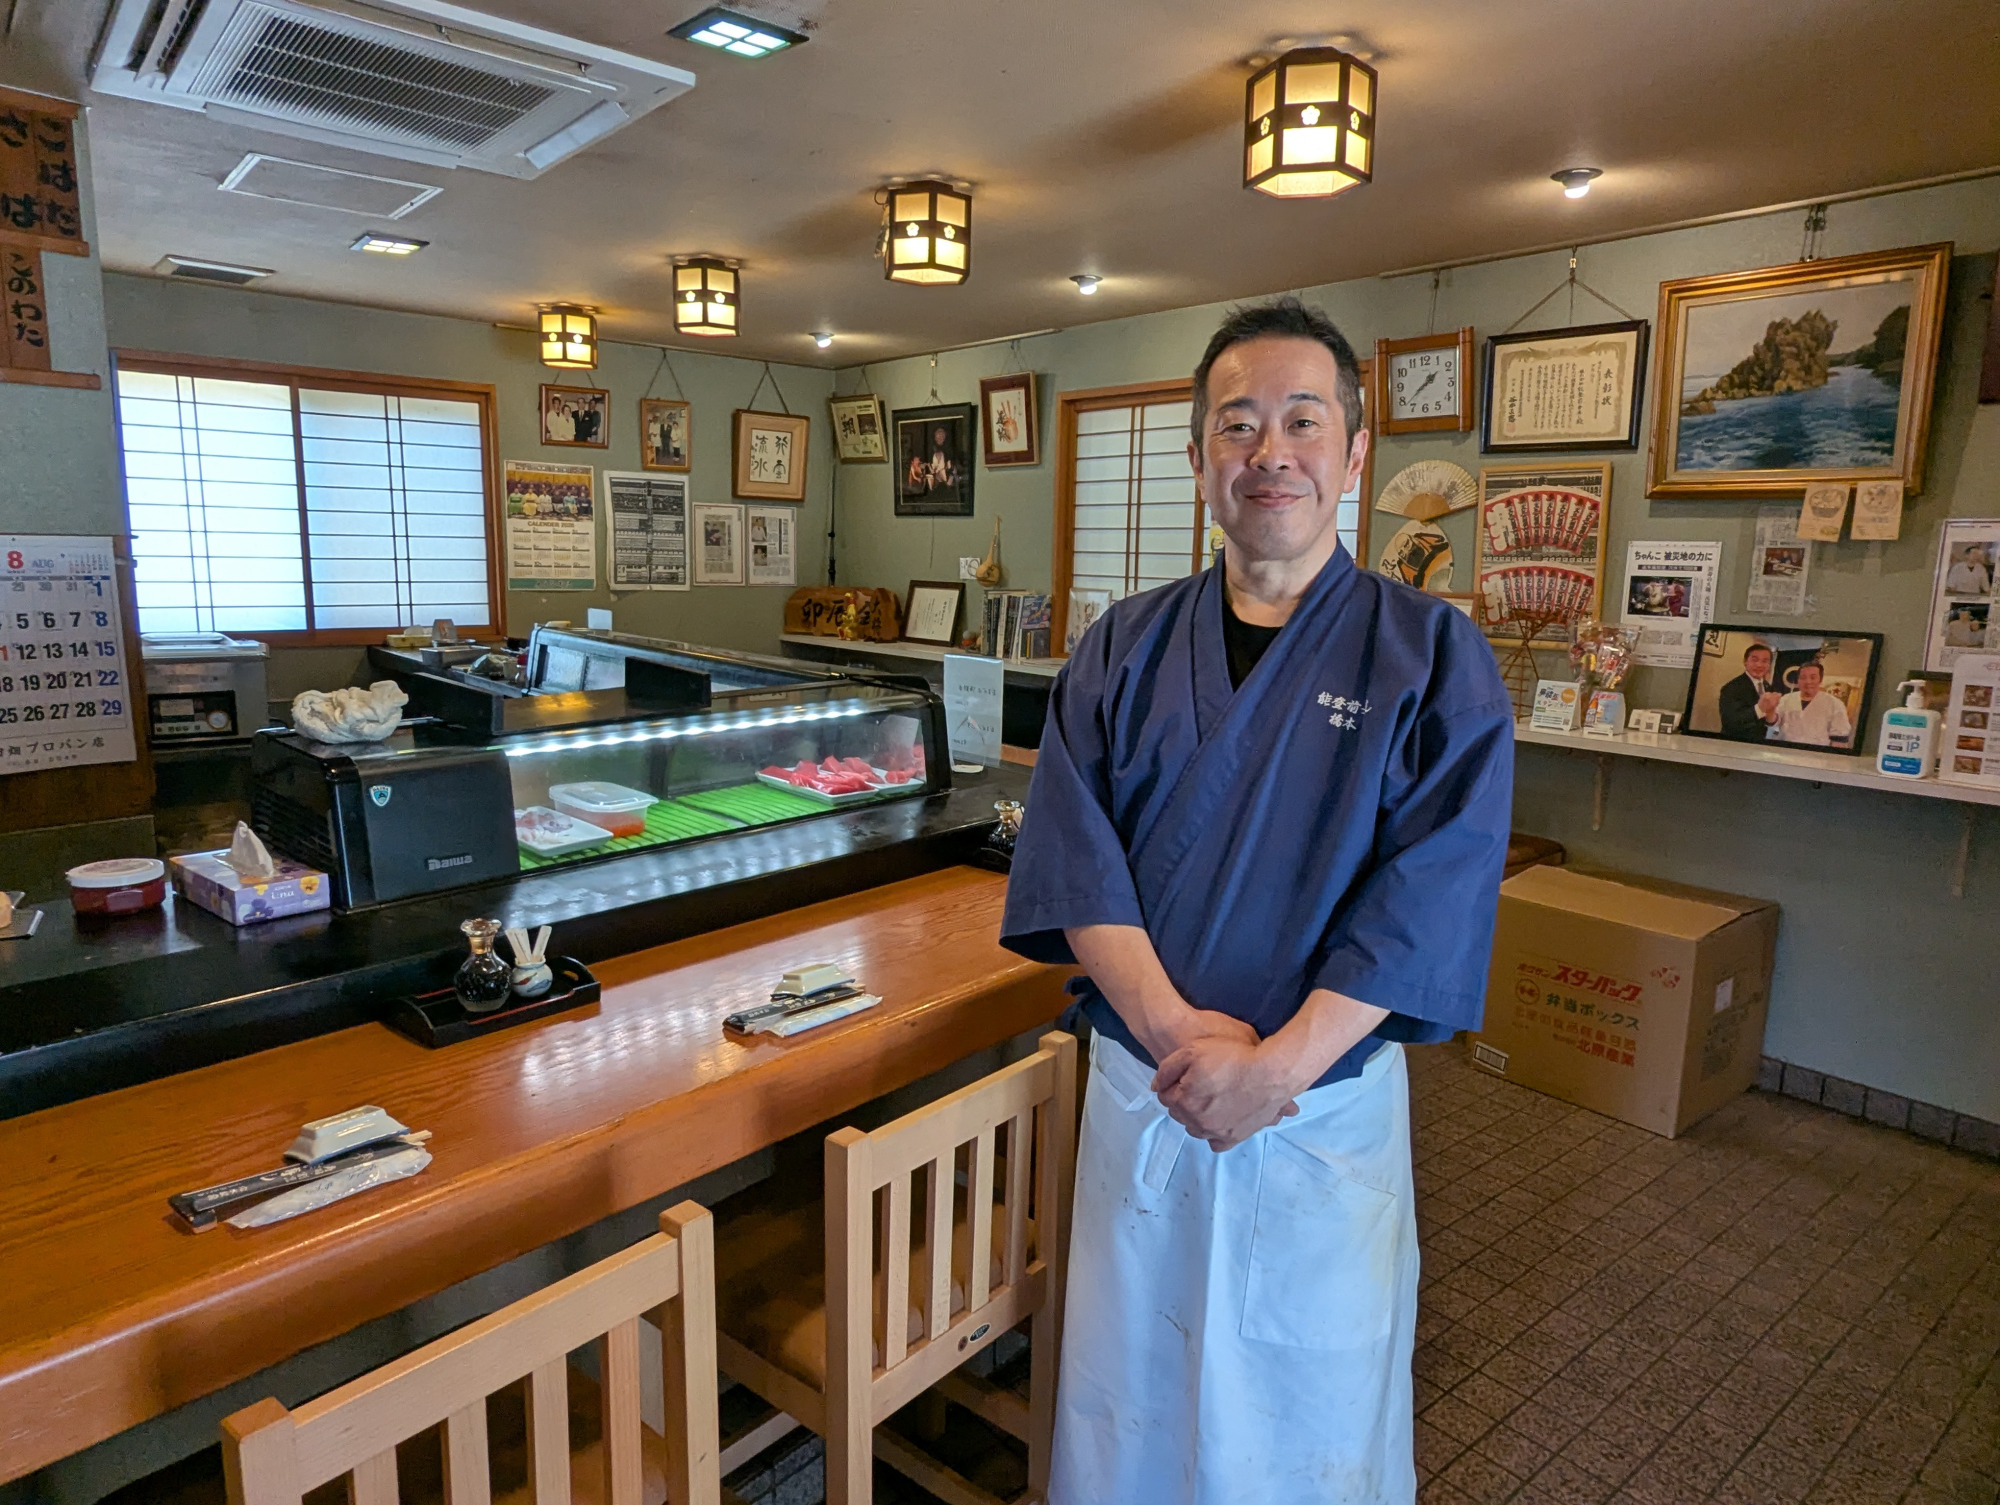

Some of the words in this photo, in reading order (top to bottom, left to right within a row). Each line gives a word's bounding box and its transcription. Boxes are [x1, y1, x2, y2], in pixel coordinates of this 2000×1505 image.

[8, 252, 44, 347] このわた
[1409, 358, 1416, 368] 11
[1420, 355, 1431, 366] 12
[1435, 355, 1440, 366] 1
[1444, 360, 1452, 371] 2
[1397, 368, 1407, 378] 10
[1397, 382, 1404, 393] 9
[1447, 377, 1455, 387] 3
[1398, 396, 1406, 406] 8
[1444, 391, 1451, 401] 4
[1410, 403, 1416, 413] 7
[1421, 403, 1429, 413] 6
[1434, 401, 1441, 411] 5
[7, 550, 24, 569] 8
[1635, 551, 1661, 560] ちゃんこ
[1664, 551, 1713, 561] 被災地の力に
[32, 559, 55, 569] AUG
[93, 581, 102, 597] 1
[17, 613, 29, 629] 5
[43, 612, 56, 629] 6
[69, 612, 81, 628] 7
[95, 611, 108, 627] 8
[0, 645, 9, 661] 1
[16, 644, 37, 660] 12
[43, 643, 63, 659] 13
[69, 642, 89, 658] 14
[95, 641, 115, 657] 15
[20, 675, 40, 691] 19
[46, 672, 67, 689] 20
[73, 672, 92, 687] 21
[97, 670, 119, 686] 22
[0, 708, 18, 724] 25
[23, 706, 45, 722] 26
[50, 704, 69, 720] 27
[75, 702, 96, 718] 28
[101, 700, 122, 716] 29
[1328, 712, 1357, 731] 橋本
[1551, 964, 1643, 1002] スターパック
[1545, 992, 1640, 1031] 弁当ボックス
